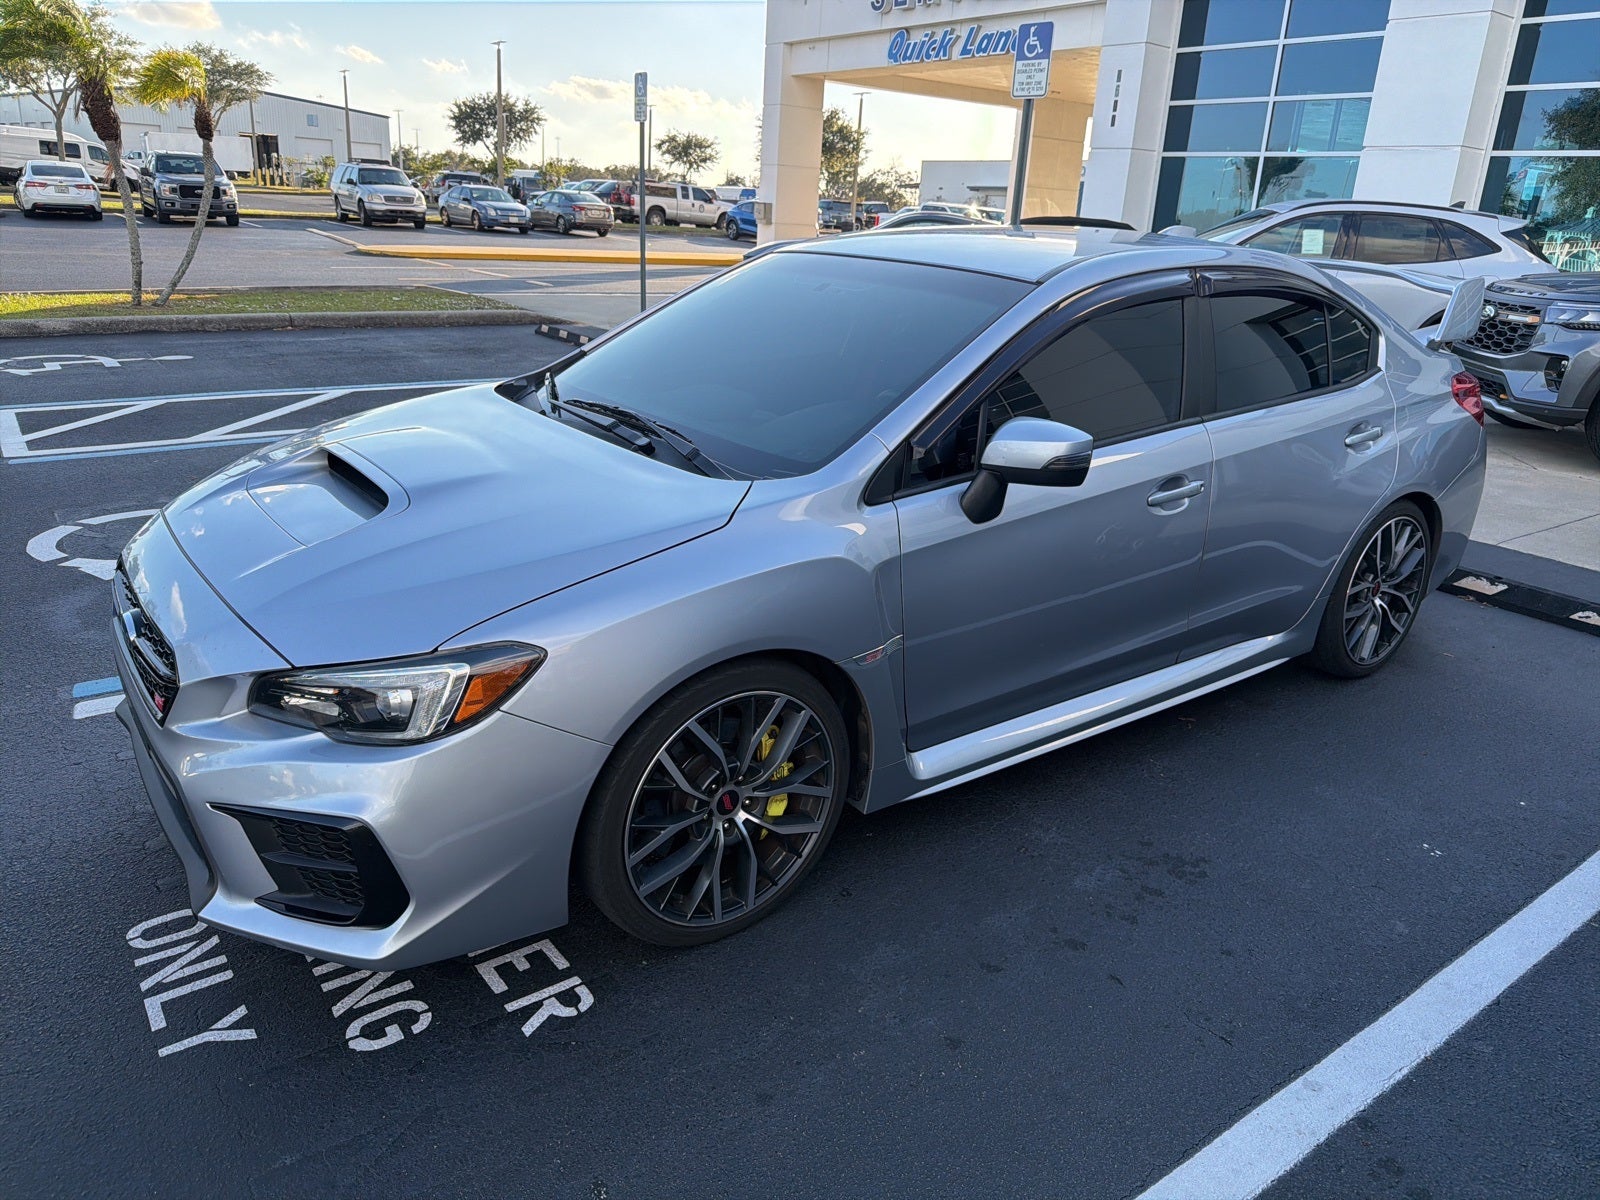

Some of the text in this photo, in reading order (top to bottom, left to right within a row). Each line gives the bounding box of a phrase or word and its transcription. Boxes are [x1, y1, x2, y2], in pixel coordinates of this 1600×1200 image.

[888, 28, 956, 64] Quick
[126, 908, 258, 1057] ONLY
[468, 939, 595, 1037] ER
